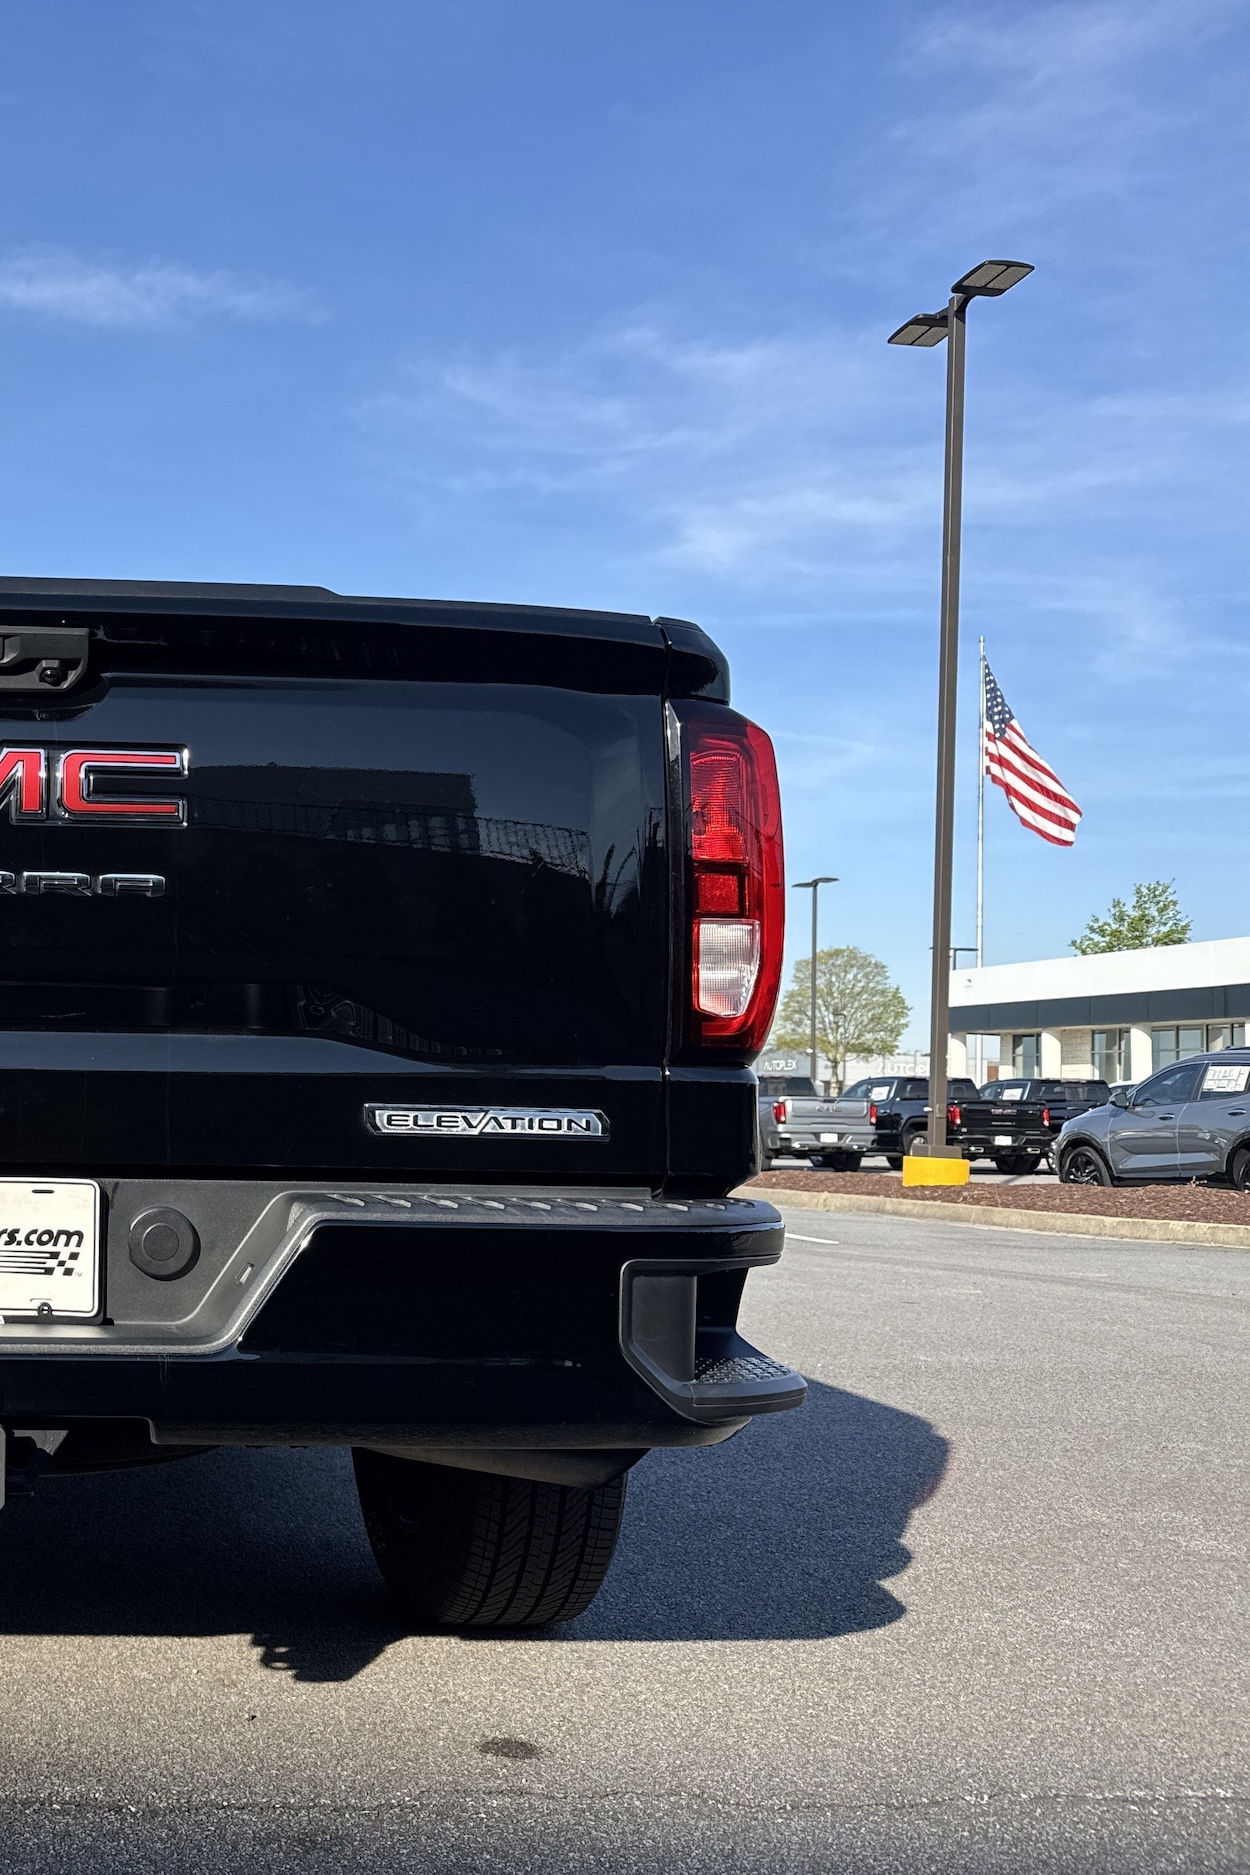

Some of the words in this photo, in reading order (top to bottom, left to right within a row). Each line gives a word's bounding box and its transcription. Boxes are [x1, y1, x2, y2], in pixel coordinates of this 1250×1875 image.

[764, 1059, 797, 1071] AUTOPLEX
[877, 1062, 927, 1075] AUTOP
[386, 1112, 591, 1132] ELEVATION
